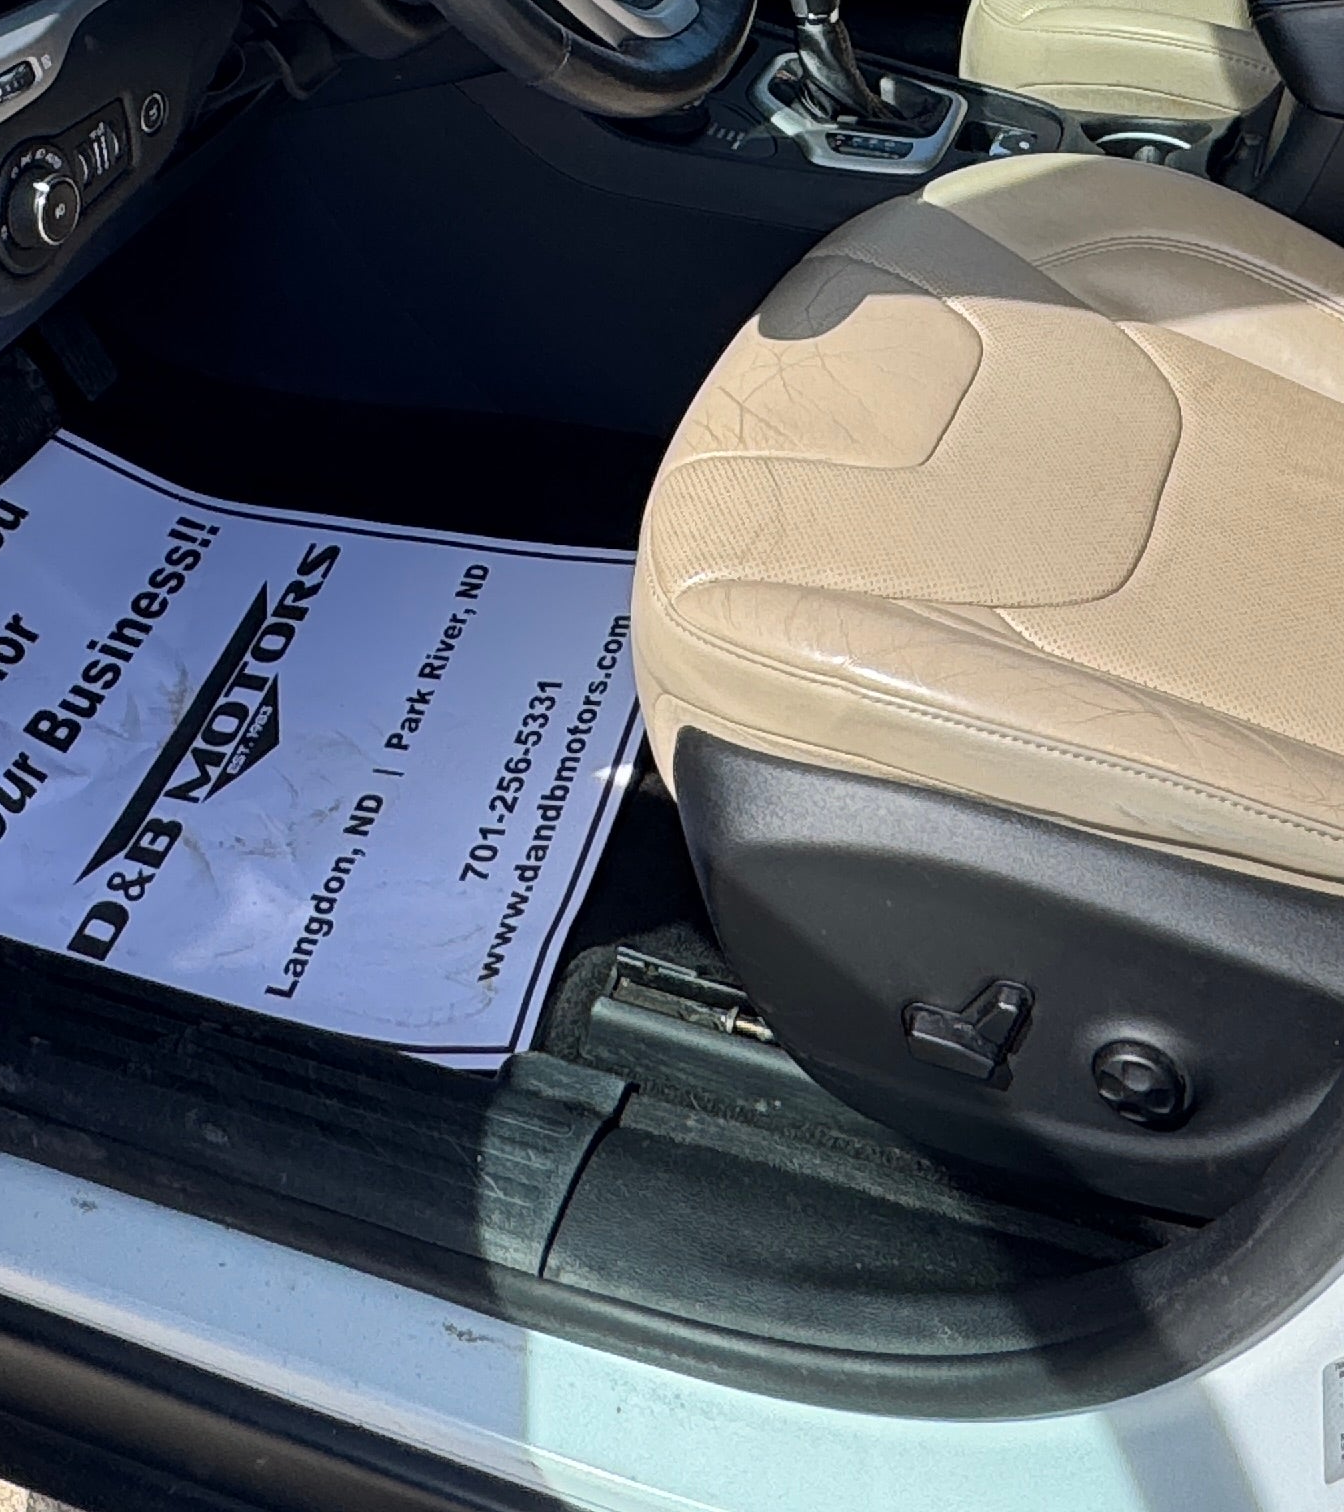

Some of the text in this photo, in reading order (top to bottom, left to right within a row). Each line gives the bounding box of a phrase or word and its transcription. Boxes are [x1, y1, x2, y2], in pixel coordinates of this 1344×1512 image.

[22, 516, 221, 754] Business!!
[66, 542, 342, 962] D&B MOTORS
[264, 848, 367, 999] Langdon,
[342, 793, 385, 838] ND
[384, 688, 436, 752] Park
[417, 608, 478, 681] River,
[454, 563, 491, 601] ND
[458, 678, 564, 883] 701-256-5331
[476, 614, 633, 983] www.dandbmotors.com
